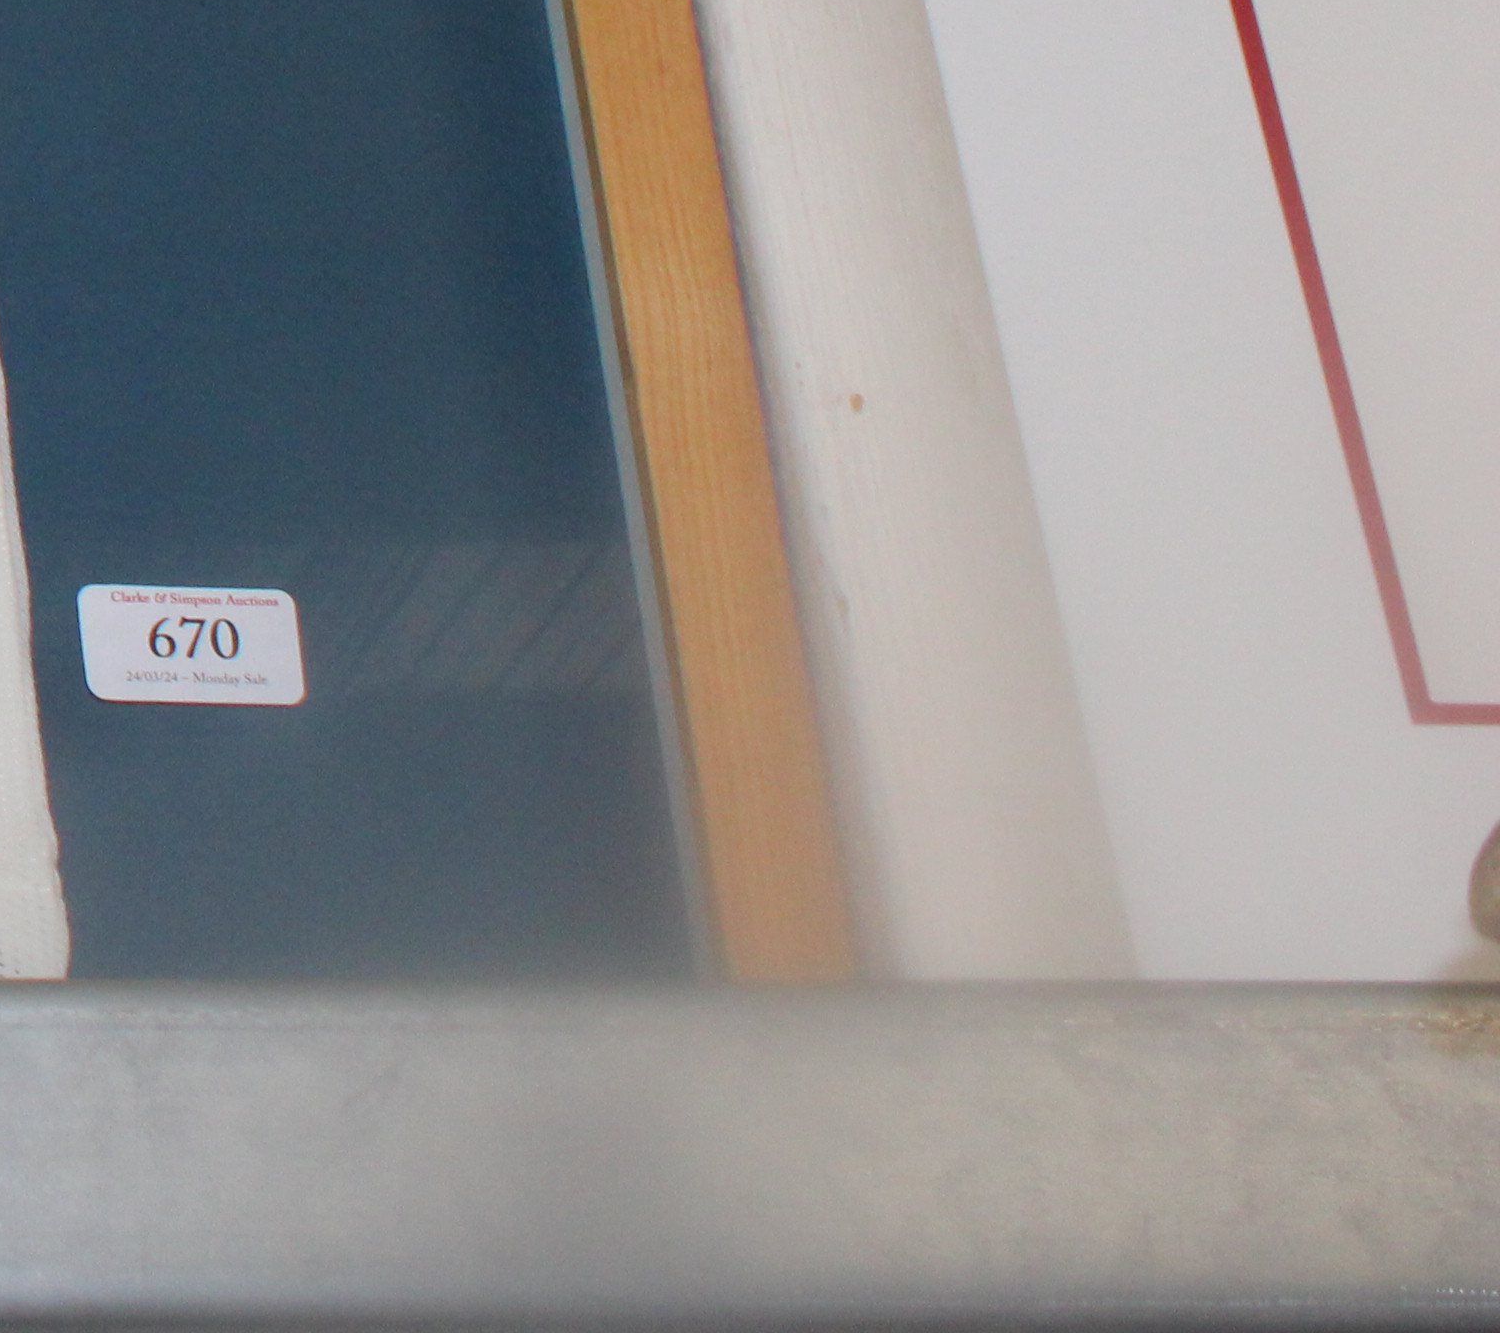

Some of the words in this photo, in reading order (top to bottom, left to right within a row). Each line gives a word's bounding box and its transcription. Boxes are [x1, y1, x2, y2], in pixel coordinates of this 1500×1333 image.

[111, 590, 149, 604] Clarke
[154, 591, 167, 604] &
[169, 591, 222, 609] Simpson
[225, 593, 279, 608] Auctions
[148, 616, 240, 660] 670
[192, 671, 240, 688] Monday
[243, 672, 268, 685] Sale
